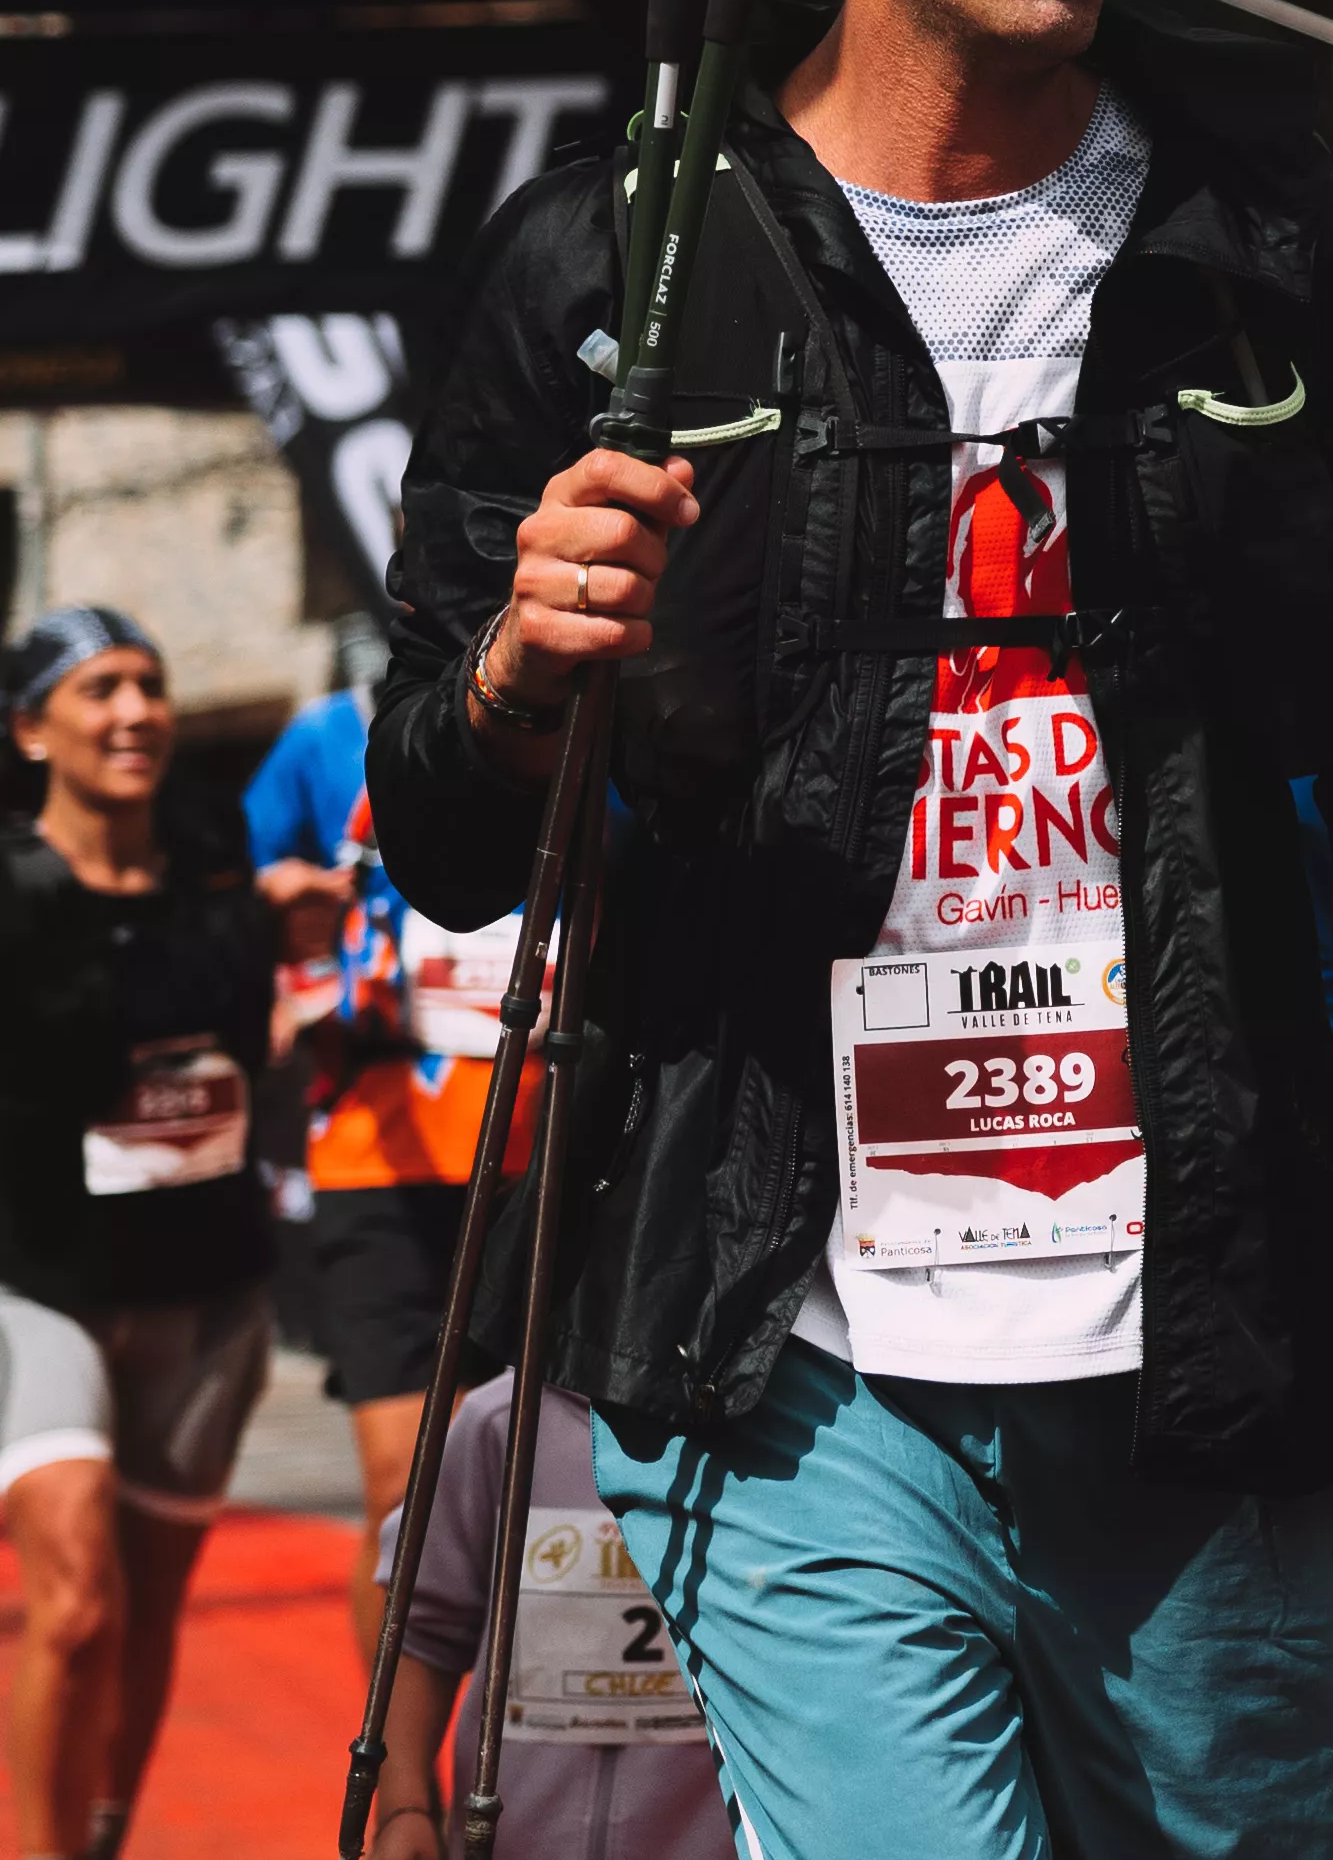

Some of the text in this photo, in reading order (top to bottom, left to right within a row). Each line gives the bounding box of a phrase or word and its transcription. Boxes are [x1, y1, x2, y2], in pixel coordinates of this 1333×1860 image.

[655, 232, 680, 305] FORCLAZ
[646, 321, 662, 348] 500
[936, 883, 1028, 926] Gavín
[867, 963, 921, 978] BASTONES
[950, 960, 1073, 1012] TRAIL
[961, 1009, 1074, 1030] VALLE DE TENA
[842, 1055, 851, 1072] 138
[843, 1074, 852, 1091] 140
[944, 1051, 1097, 1111] 2389
[844, 1093, 853, 1111] 614
[970, 1111, 1077, 1133] LUCAS ROCA
[845, 1112, 858, 1179] emergencias:
[958, 1226, 988, 1242] VALLE
[881, 1246, 933, 1257] Panticosa
